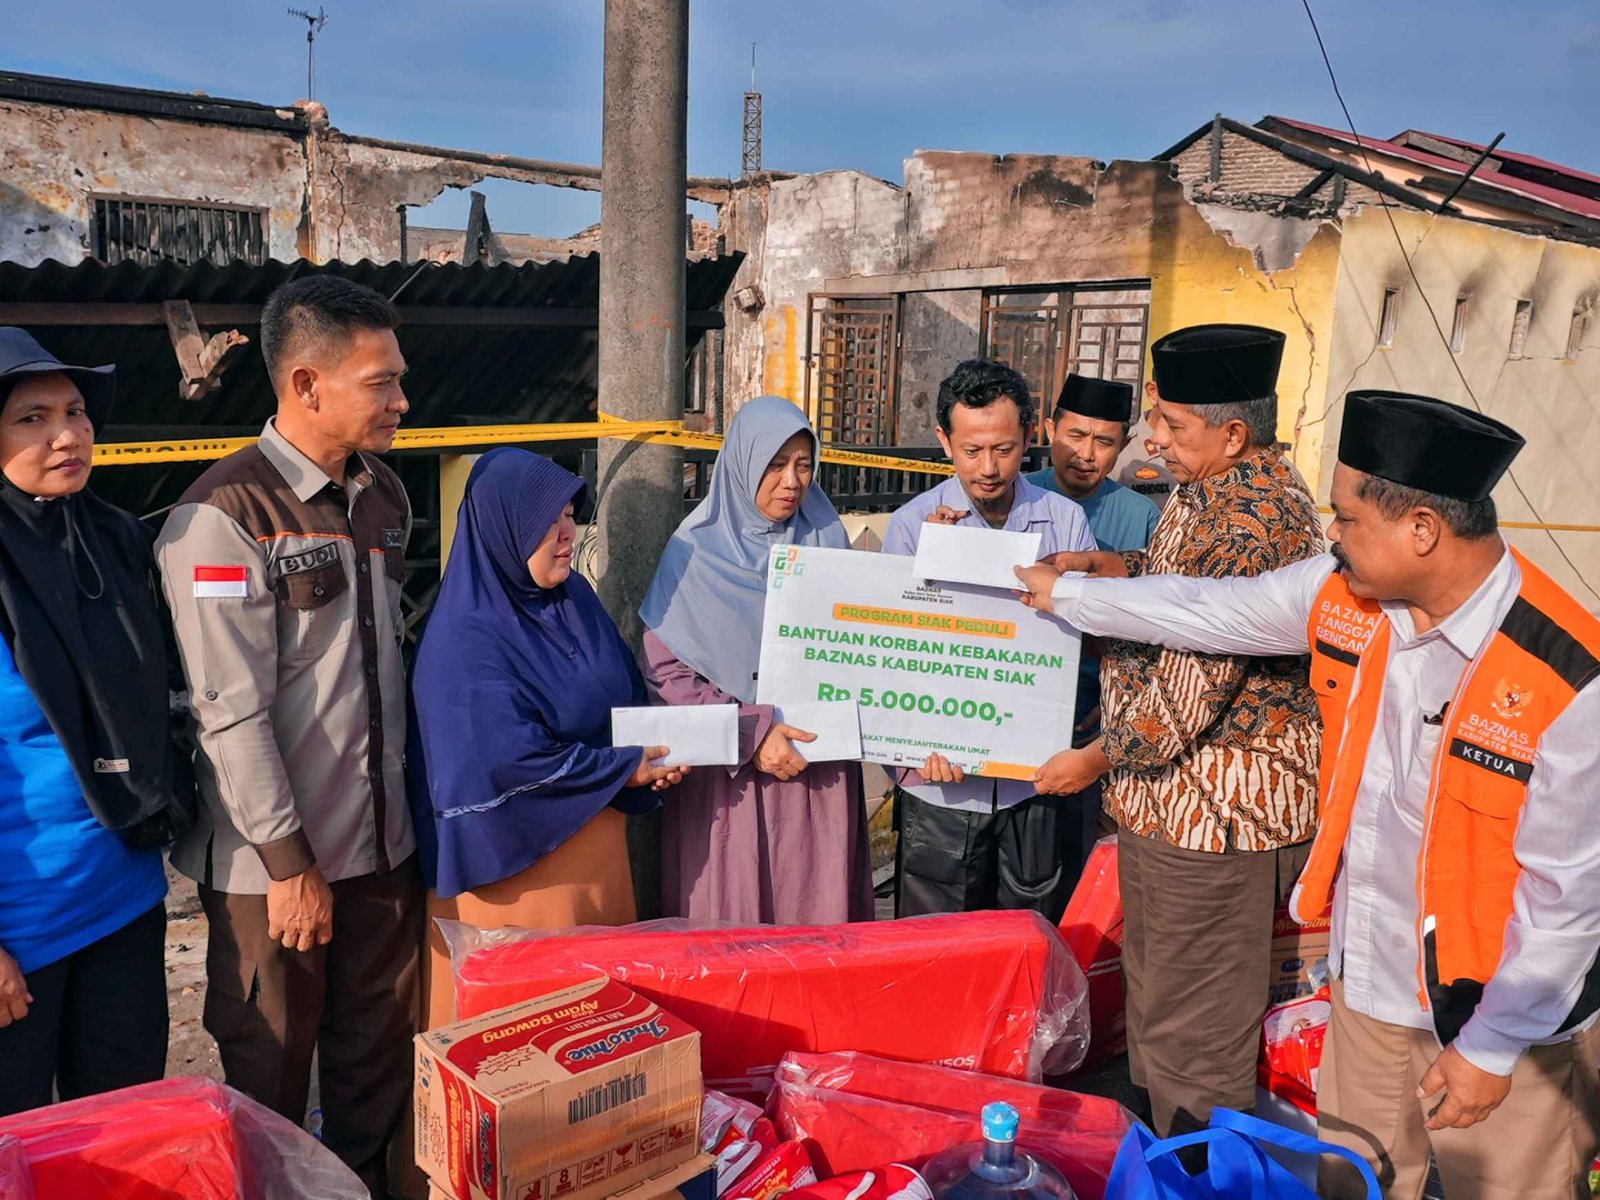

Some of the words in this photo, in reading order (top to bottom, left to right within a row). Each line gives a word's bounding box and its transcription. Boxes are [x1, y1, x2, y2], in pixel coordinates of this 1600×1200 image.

[284, 545, 335, 573] BUDI
[902, 594, 938, 603] KABUPATEN
[840, 606, 914, 625] PROGRAM
[917, 615, 952, 629] SIAK
[955, 620, 1009, 636] PEDULI
[1318, 612, 1372, 639] TANGGA
[1321, 600, 1375, 627] BAZNA
[778, 624, 865, 646] BANTUAN
[869, 634, 945, 656] KORBAN
[949, 643, 1064, 669] KEBAKARAN
[1316, 625, 1366, 652] BENCAN
[804, 647, 877, 668] BAZNAS
[881, 655, 989, 681] KABUPATEN
[993, 668, 1037, 687] SIAK
[817, 682, 852, 702] Rp
[858, 687, 1014, 727] 5.000.000,-
[1468, 713, 1530, 745] BAZNAS
[861, 733, 883, 743] AKAT
[884, 736, 967, 753] MENYEJAHTERAKAN
[967, 745, 992, 756] UMAT
[1457, 727, 1507, 753] KABUPATEN
[1511, 748, 1534, 761] SIAK
[1462, 745, 1516, 777] KETUA
[554, 1000, 599, 1019] Ayam
[481, 1014, 553, 1044] Bawang
[560, 1169, 569, 1183] 8
